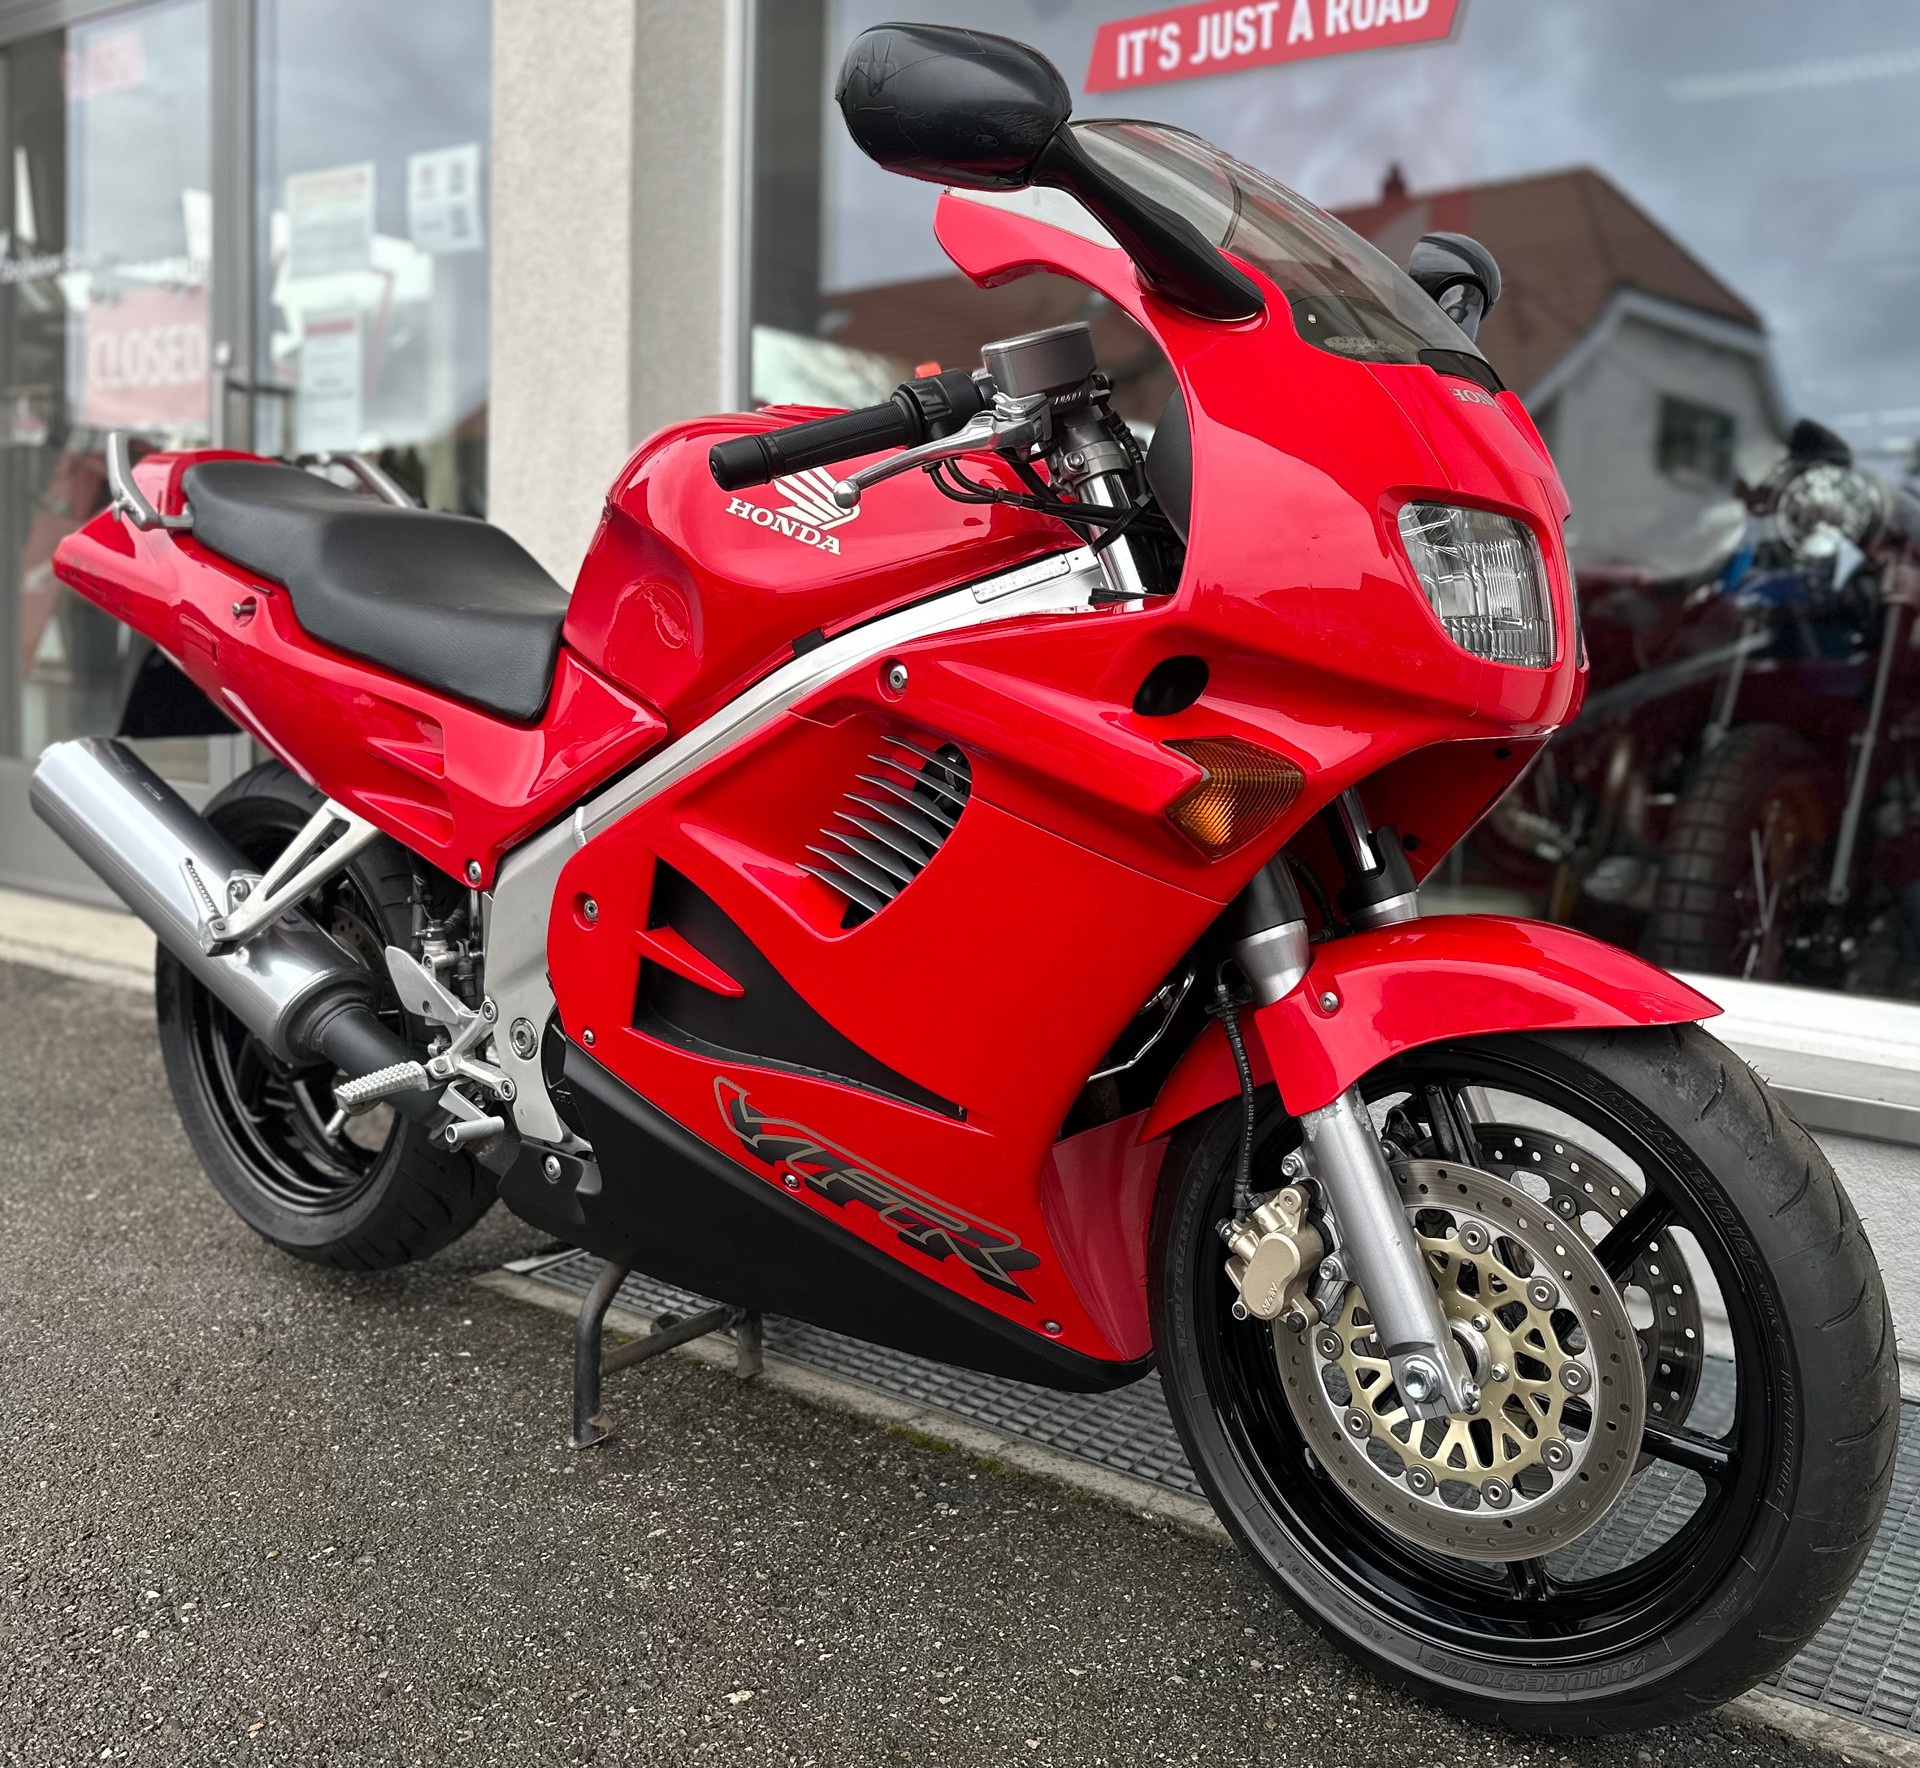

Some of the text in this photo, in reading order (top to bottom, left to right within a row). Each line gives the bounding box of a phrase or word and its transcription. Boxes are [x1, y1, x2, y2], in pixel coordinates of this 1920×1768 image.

[1116, 21, 1181, 80] IT'S
[1189, 1, 1280, 65] JUST
[1286, 0, 1314, 45] A
[87, 322, 208, 389] CLOSED
[725, 496, 842, 556] HONDA
[712, 1075, 1041, 1304] VFR
[1422, 1652, 1650, 1693] BRIDGESTONE
